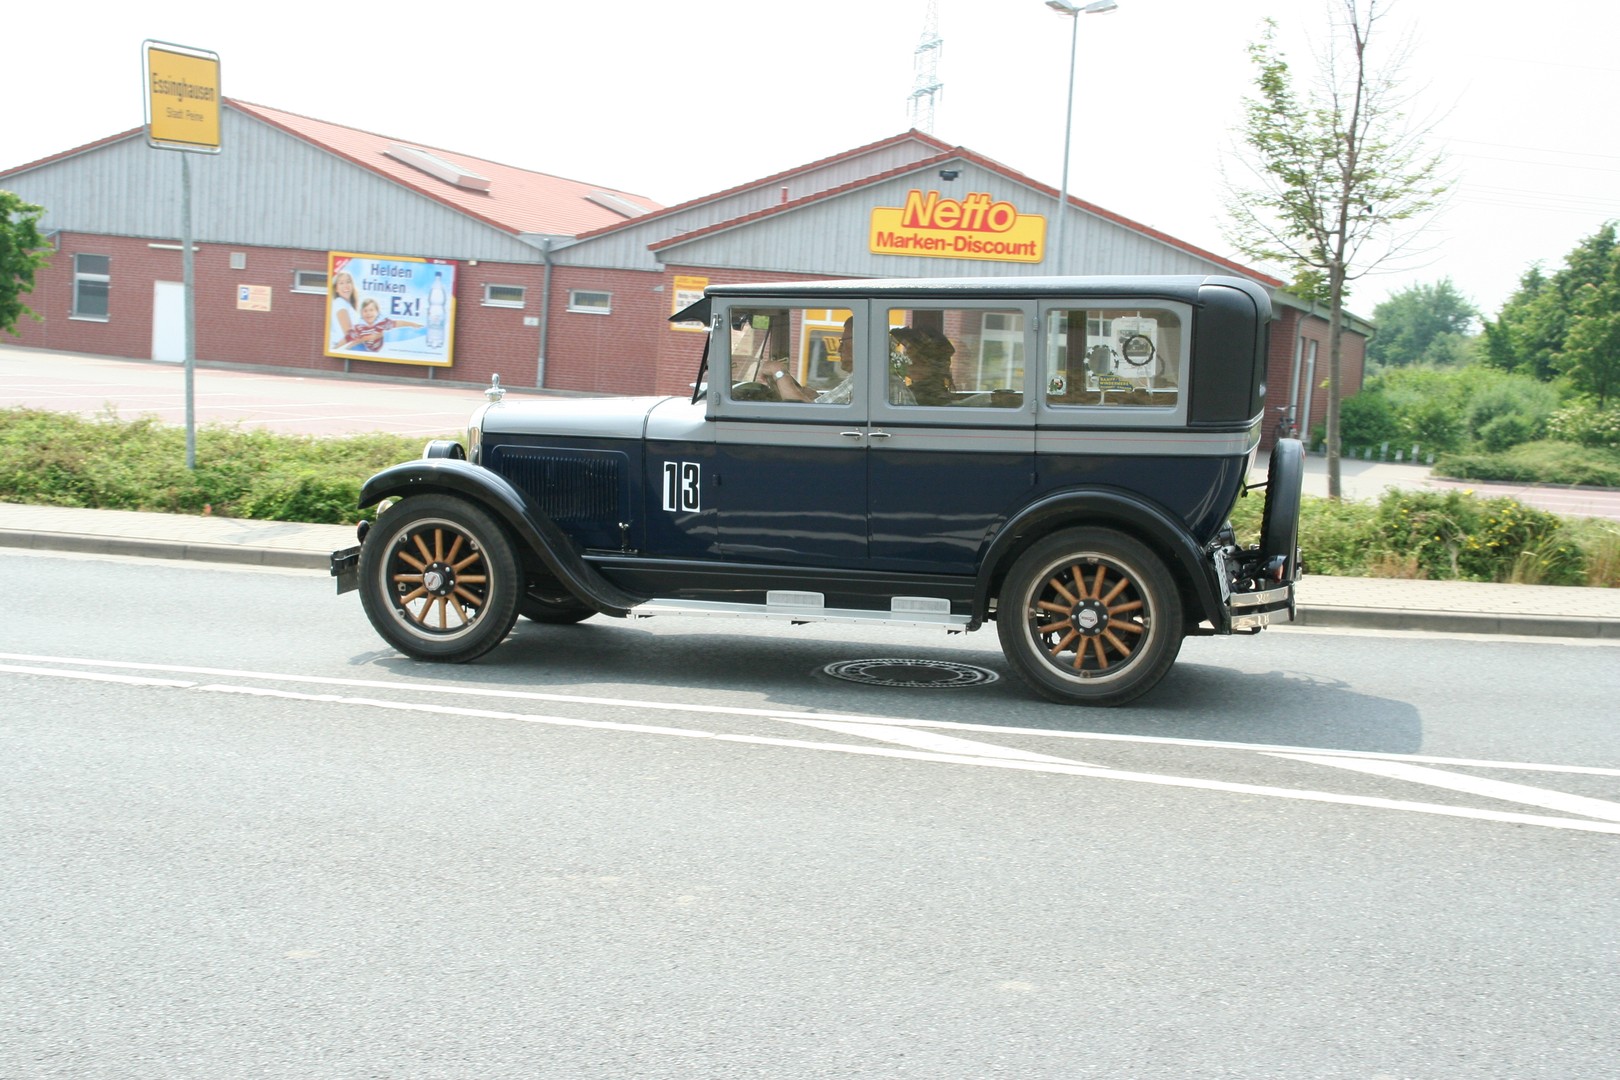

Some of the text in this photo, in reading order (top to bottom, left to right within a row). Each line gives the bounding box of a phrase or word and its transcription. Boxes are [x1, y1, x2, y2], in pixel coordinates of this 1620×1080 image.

[152, 72, 214, 102] Essinghausen
[902, 190, 1016, 232] Netto
[876, 231, 1037, 256] Marken-Discount
[370, 263, 412, 278] Helden
[362, 278, 406, 293] trinken
[391, 295, 421, 317] Ex!
[664, 462, 699, 510] 13
